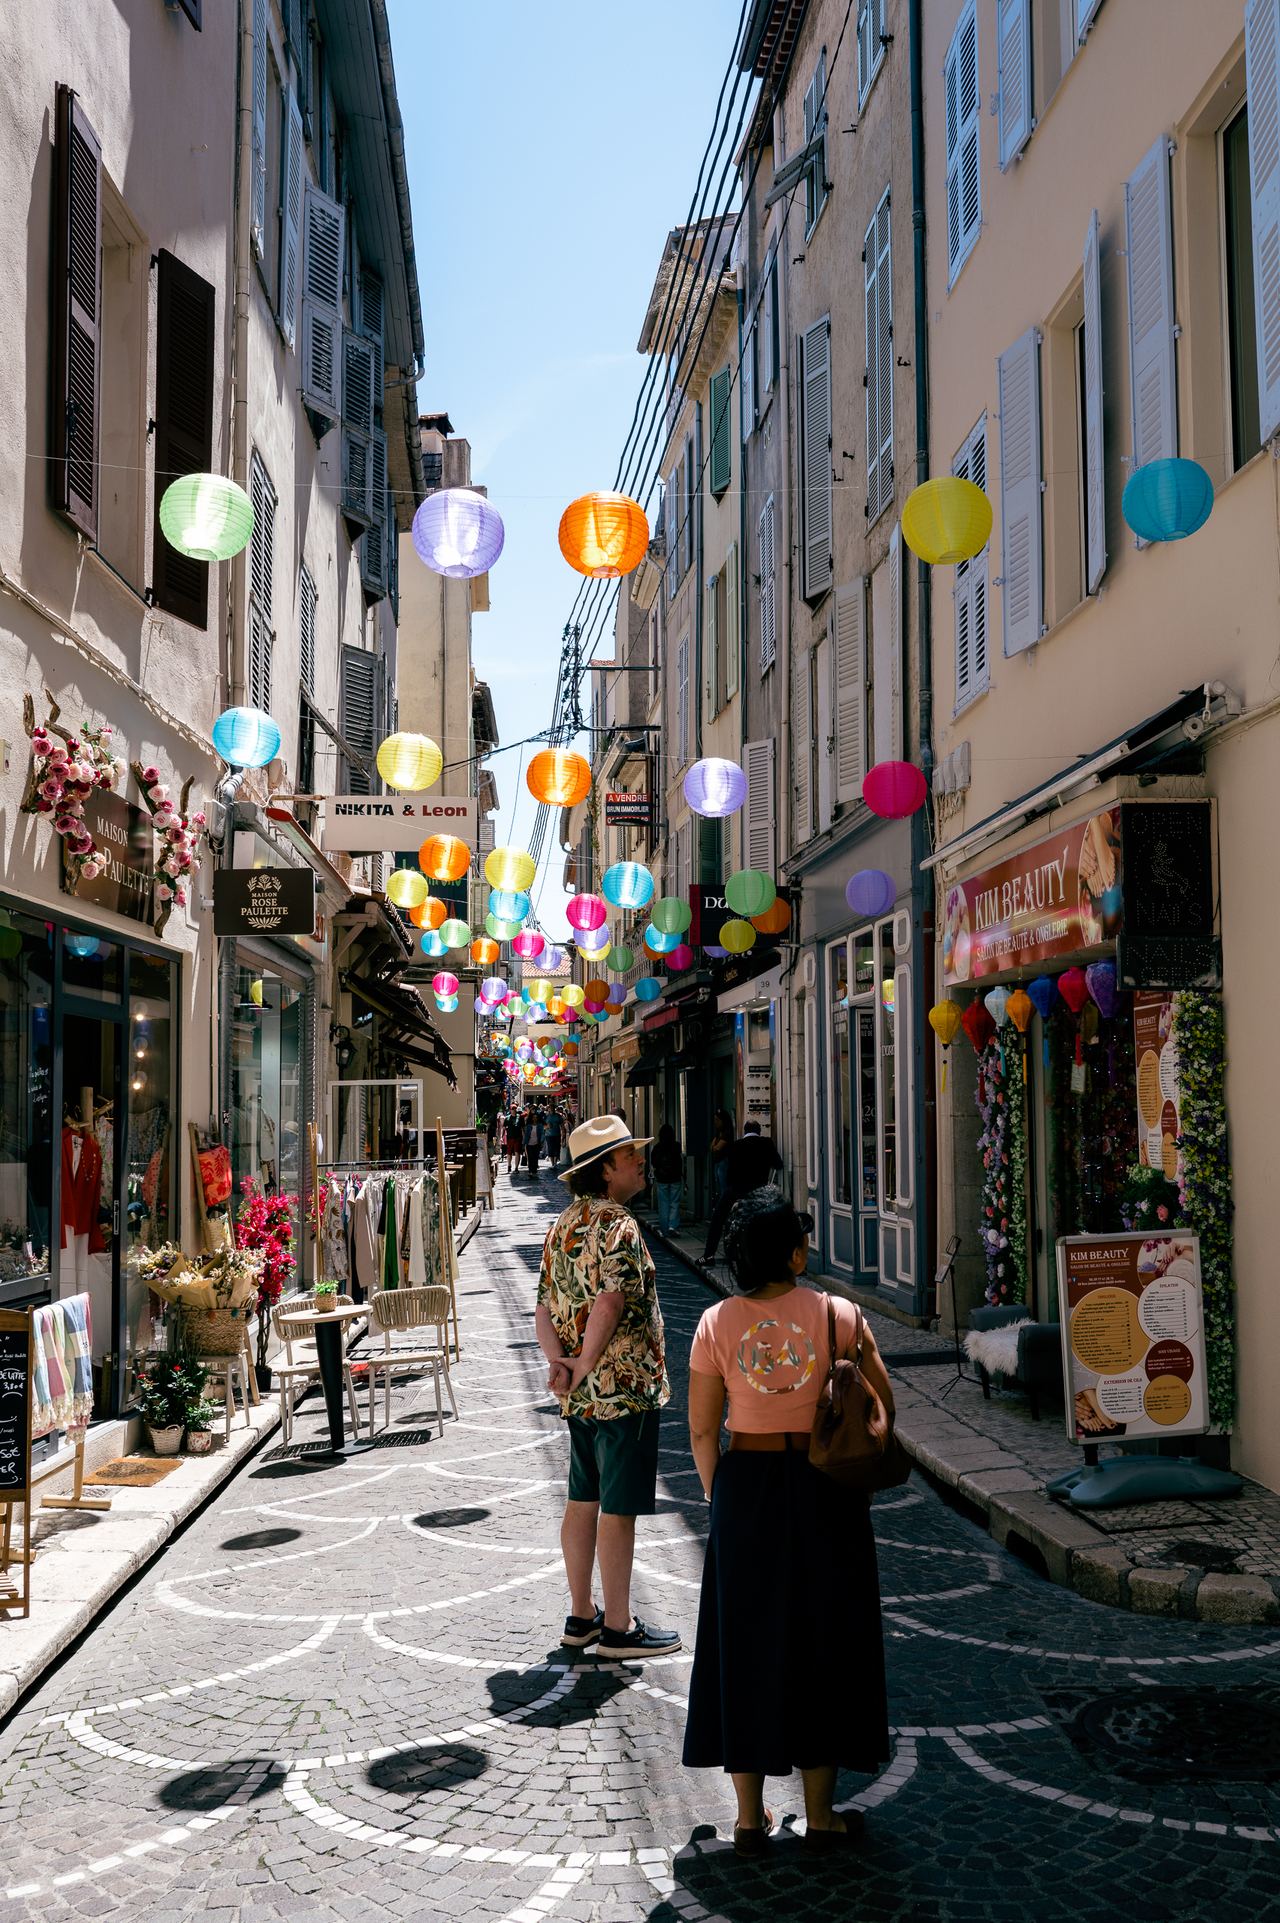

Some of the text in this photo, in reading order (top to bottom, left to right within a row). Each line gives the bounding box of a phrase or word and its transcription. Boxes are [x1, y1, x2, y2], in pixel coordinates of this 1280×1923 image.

[335, 803, 468, 817] NIKITA & Leon
[615, 794, 648, 802] VENDRE
[621, 805, 650, 813] IMMOBILIER
[96, 815, 129, 848] MAISON
[1131, 811, 1202, 835] OPEN
[102, 846, 150, 896] PAULETTE
[974, 844, 1069, 933] KIM BEAUTY
[240, 906, 289, 916] PAULETTE
[251, 898, 278, 907] ROSE
[1136, 901, 1202, 926] NAILS
[976, 918, 1069, 962] SALON DE BEAUTÉ & ONGLERIE
[1126, 943, 1215, 967] NAILS
[1070, 1247, 1129, 1261] KIM BEAUTY
